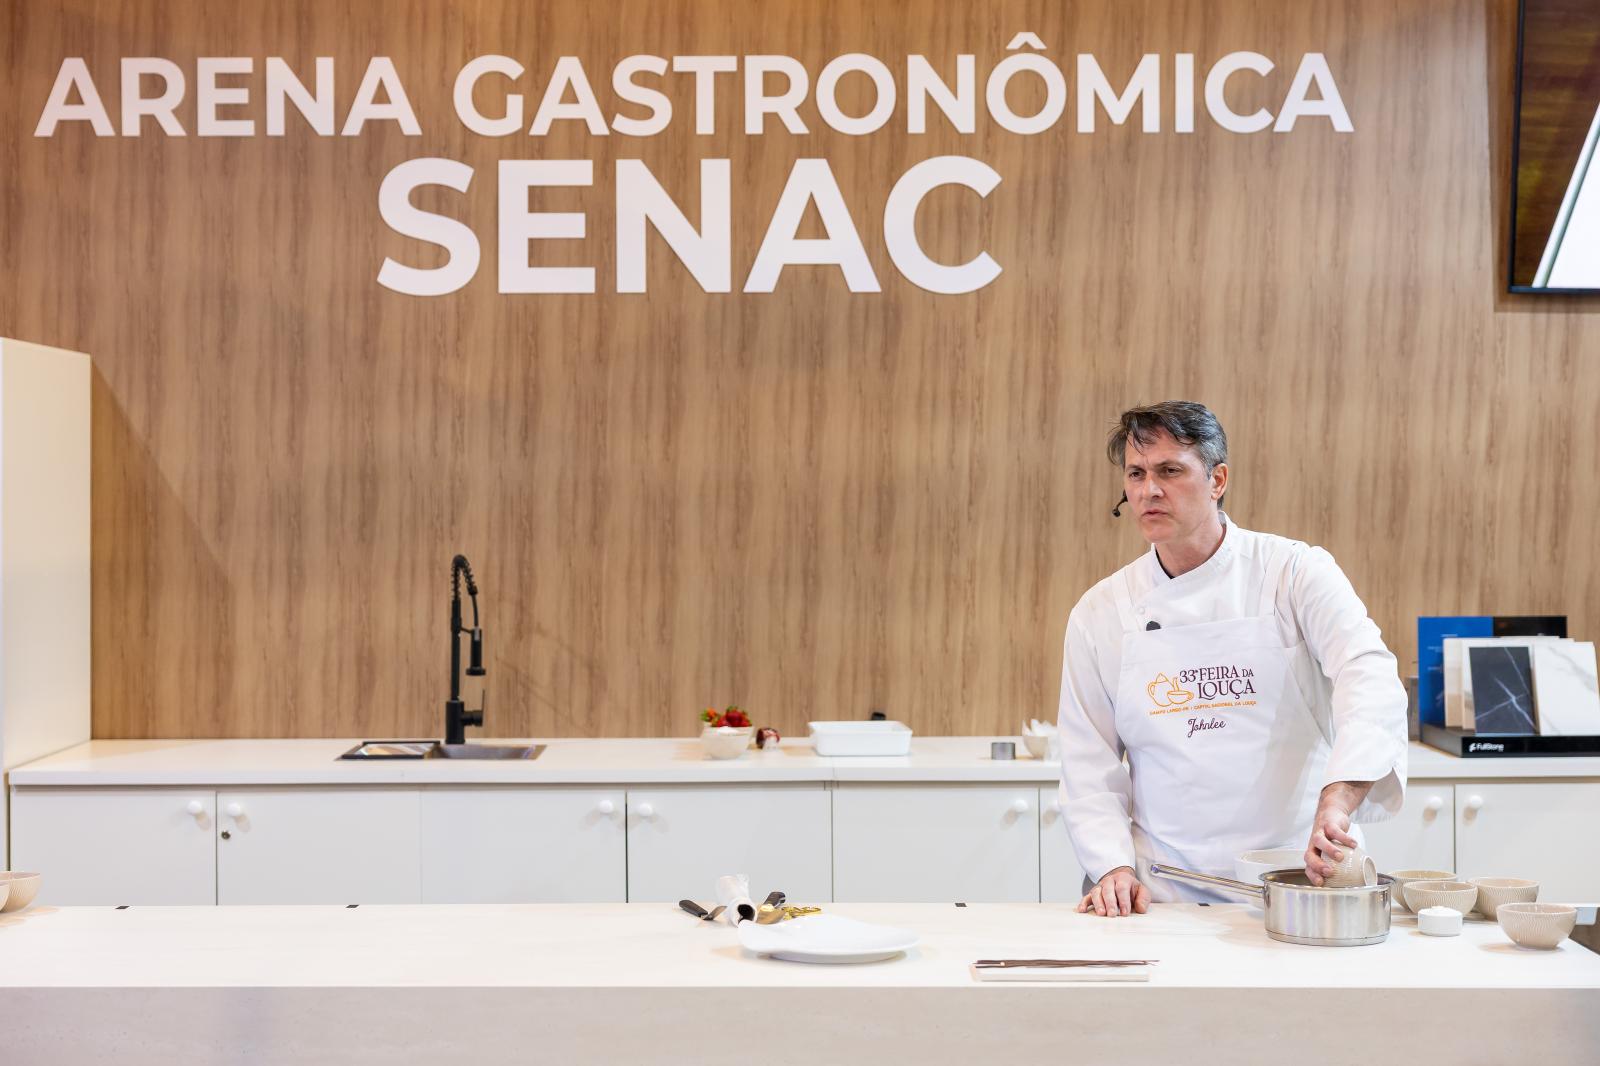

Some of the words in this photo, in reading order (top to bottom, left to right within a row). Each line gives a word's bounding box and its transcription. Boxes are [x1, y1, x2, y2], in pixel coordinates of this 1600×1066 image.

[35, 56, 422, 137] ARENA
[453, 32, 1355, 137] GASTRONÔMICA
[377, 156, 1003, 296] SENAC
[1197, 679, 1256, 700] LOUÇA
[1199, 665, 1239, 680] FEIRA
[1242, 668, 1254, 677] DA
